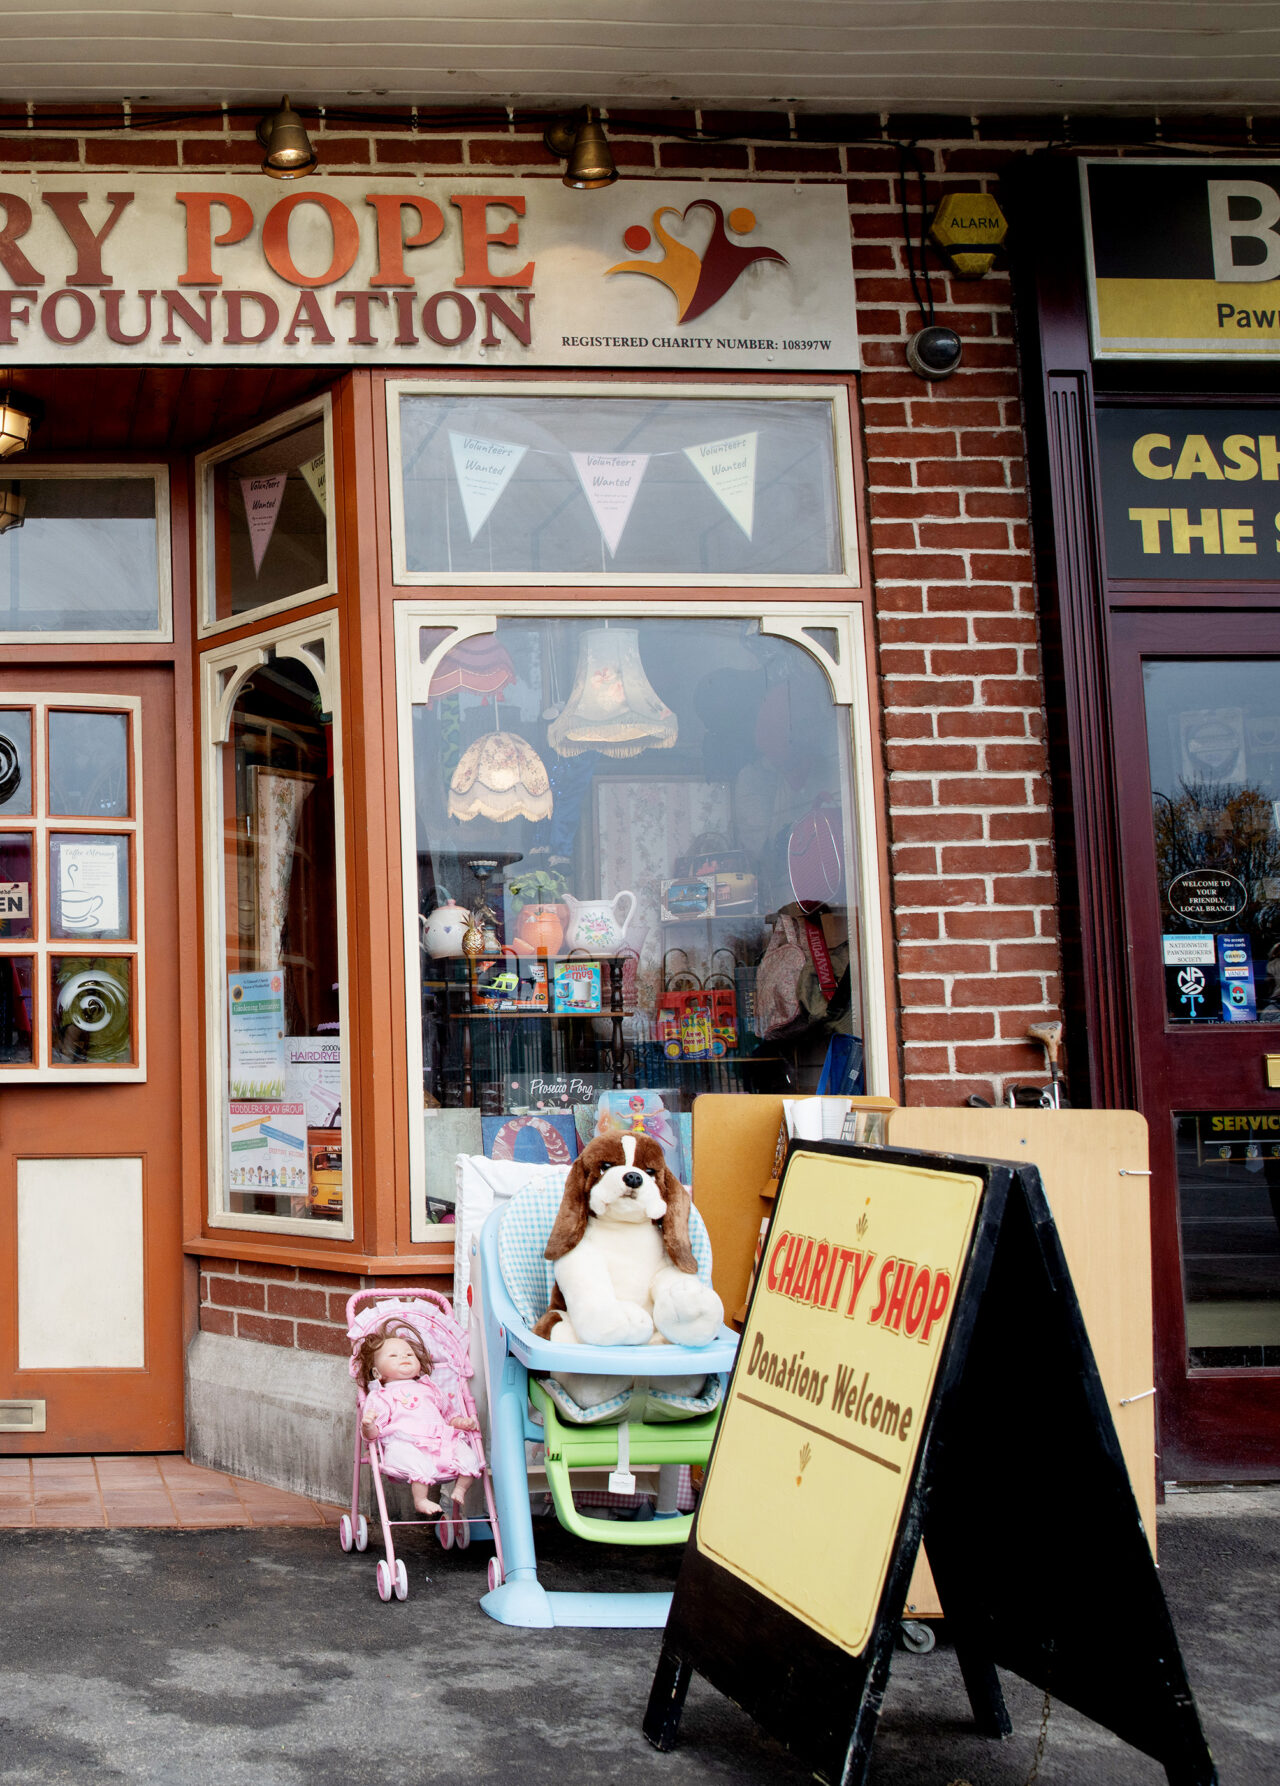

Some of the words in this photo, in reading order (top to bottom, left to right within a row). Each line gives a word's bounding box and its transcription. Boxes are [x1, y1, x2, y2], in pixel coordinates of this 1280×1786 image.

[951, 218, 1000, 230] ALARM
[176, 190, 535, 287] POPE
[1216, 303, 1280, 329] Paw
[561, 336, 649, 348] REGISTERED
[651, 336, 713, 349] CHARITY
[717, 338, 779, 350] NUMBER:
[782, 339, 832, 350] 108397W
[463, 437, 512, 457] Volunteers
[700, 440, 747, 457] Volunteers
[465, 459, 505, 476] Wanted
[587, 455, 636, 467] Volunteers
[711, 456, 747, 476] Wanted
[250, 478, 280, 491] Volunteers
[592, 476, 632, 487] Wanted
[252, 498, 276, 510] Wanted
[1128, 507, 1257, 554] THE
[571, 969, 593, 980] mug
[290, 1051, 340, 1060] HAIRDRYE
[529, 1079, 568, 1094] Prosecco
[570, 1079, 594, 1100] Pong
[231, 1104, 264, 1114] TODDLERS
[265, 1104, 280, 1114] PLAY
[281, 1104, 304, 1114] GROUP
[1211, 1115, 1280, 1131] SERVIC
[767, 1231, 876, 1319] CHARITY
[868, 1257, 952, 1345] SHOP
[747, 1331, 829, 1406] Donations
[831, 1363, 913, 1442] Welcome
